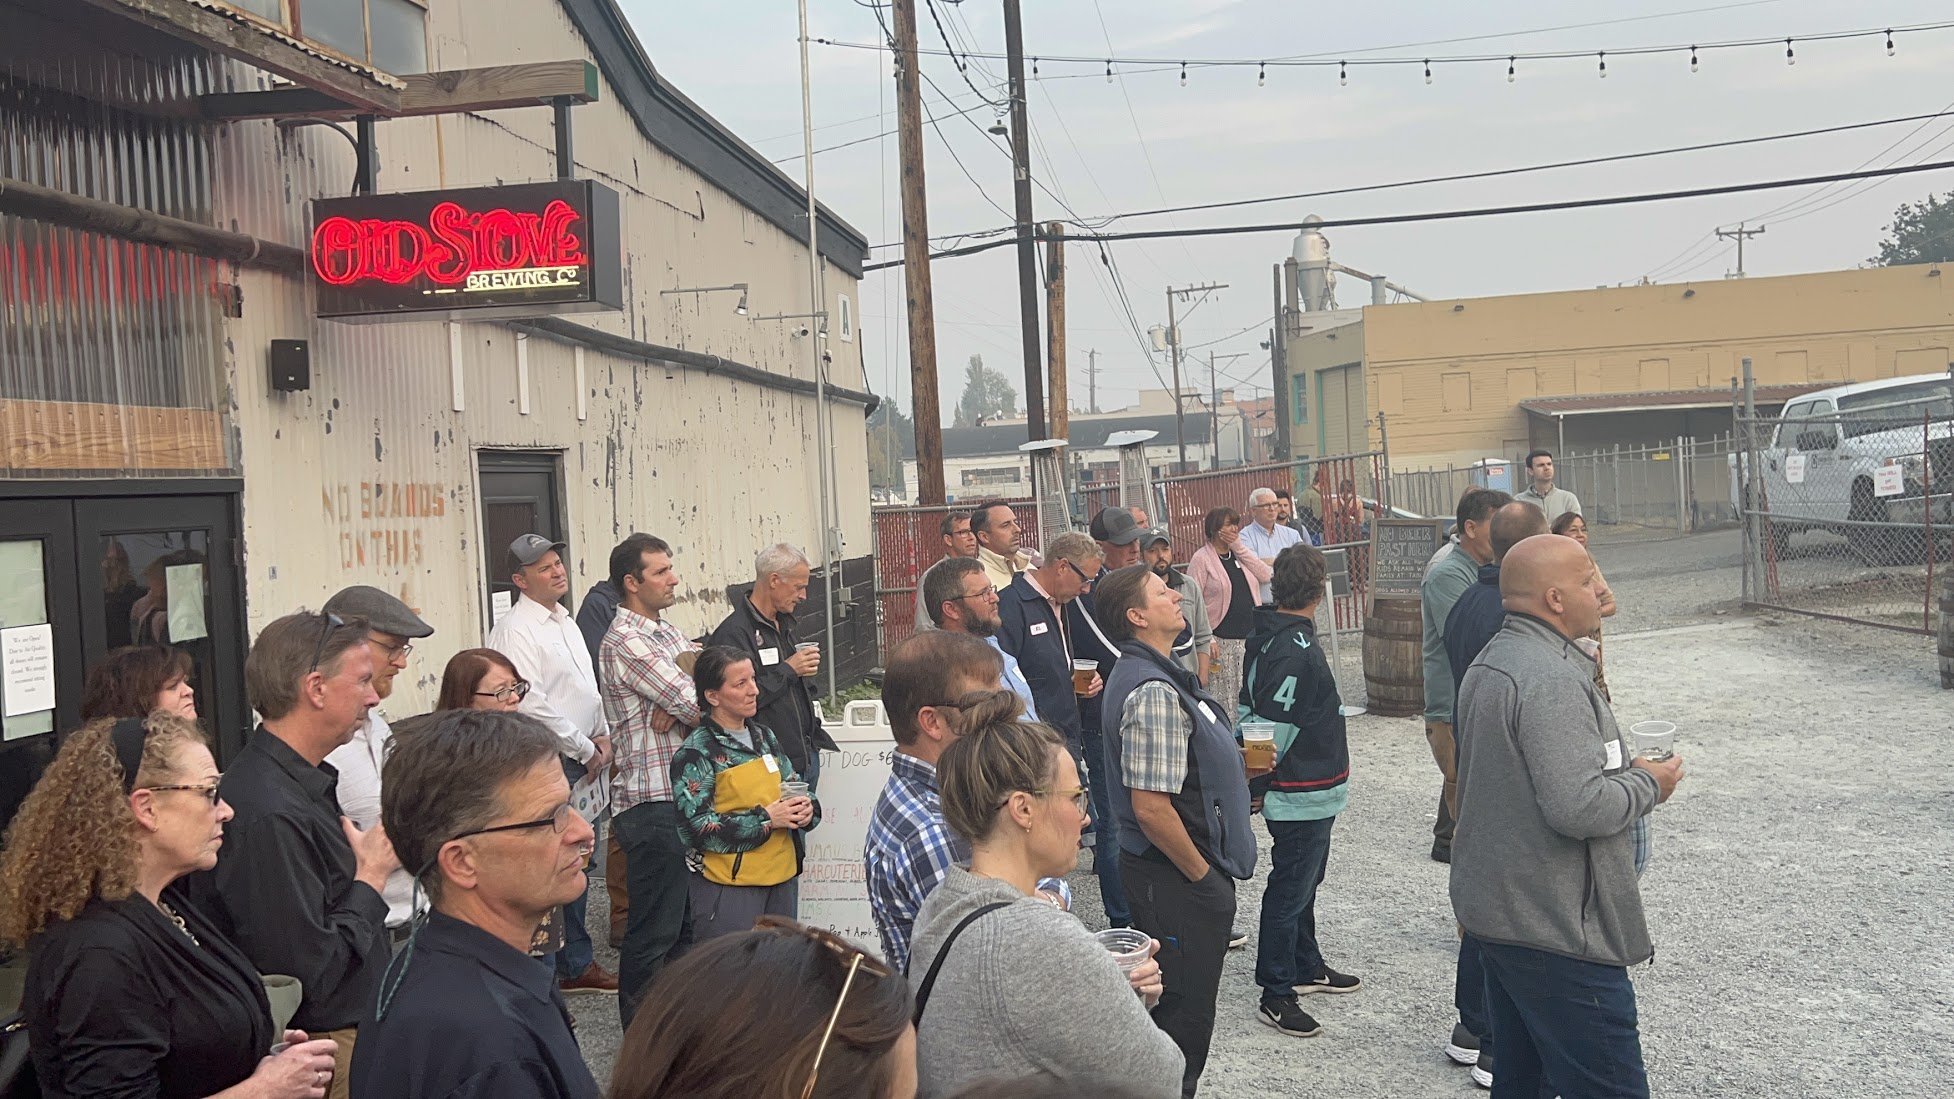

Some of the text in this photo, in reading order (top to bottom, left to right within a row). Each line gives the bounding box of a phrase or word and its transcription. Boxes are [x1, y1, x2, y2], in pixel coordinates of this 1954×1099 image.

[466, 271, 550, 289] BREWING
[322, 484, 350, 524] NO
[1379, 527, 1431, 541] NO BEER
[371, 528, 423, 567] THIS
[1378, 542, 1407, 557] PAST
[1273, 675, 1298, 712] 4
[820, 751, 836, 768] OT
[841, 751, 873, 768] DOG
[802, 863, 867, 880] HARCUTERIE
